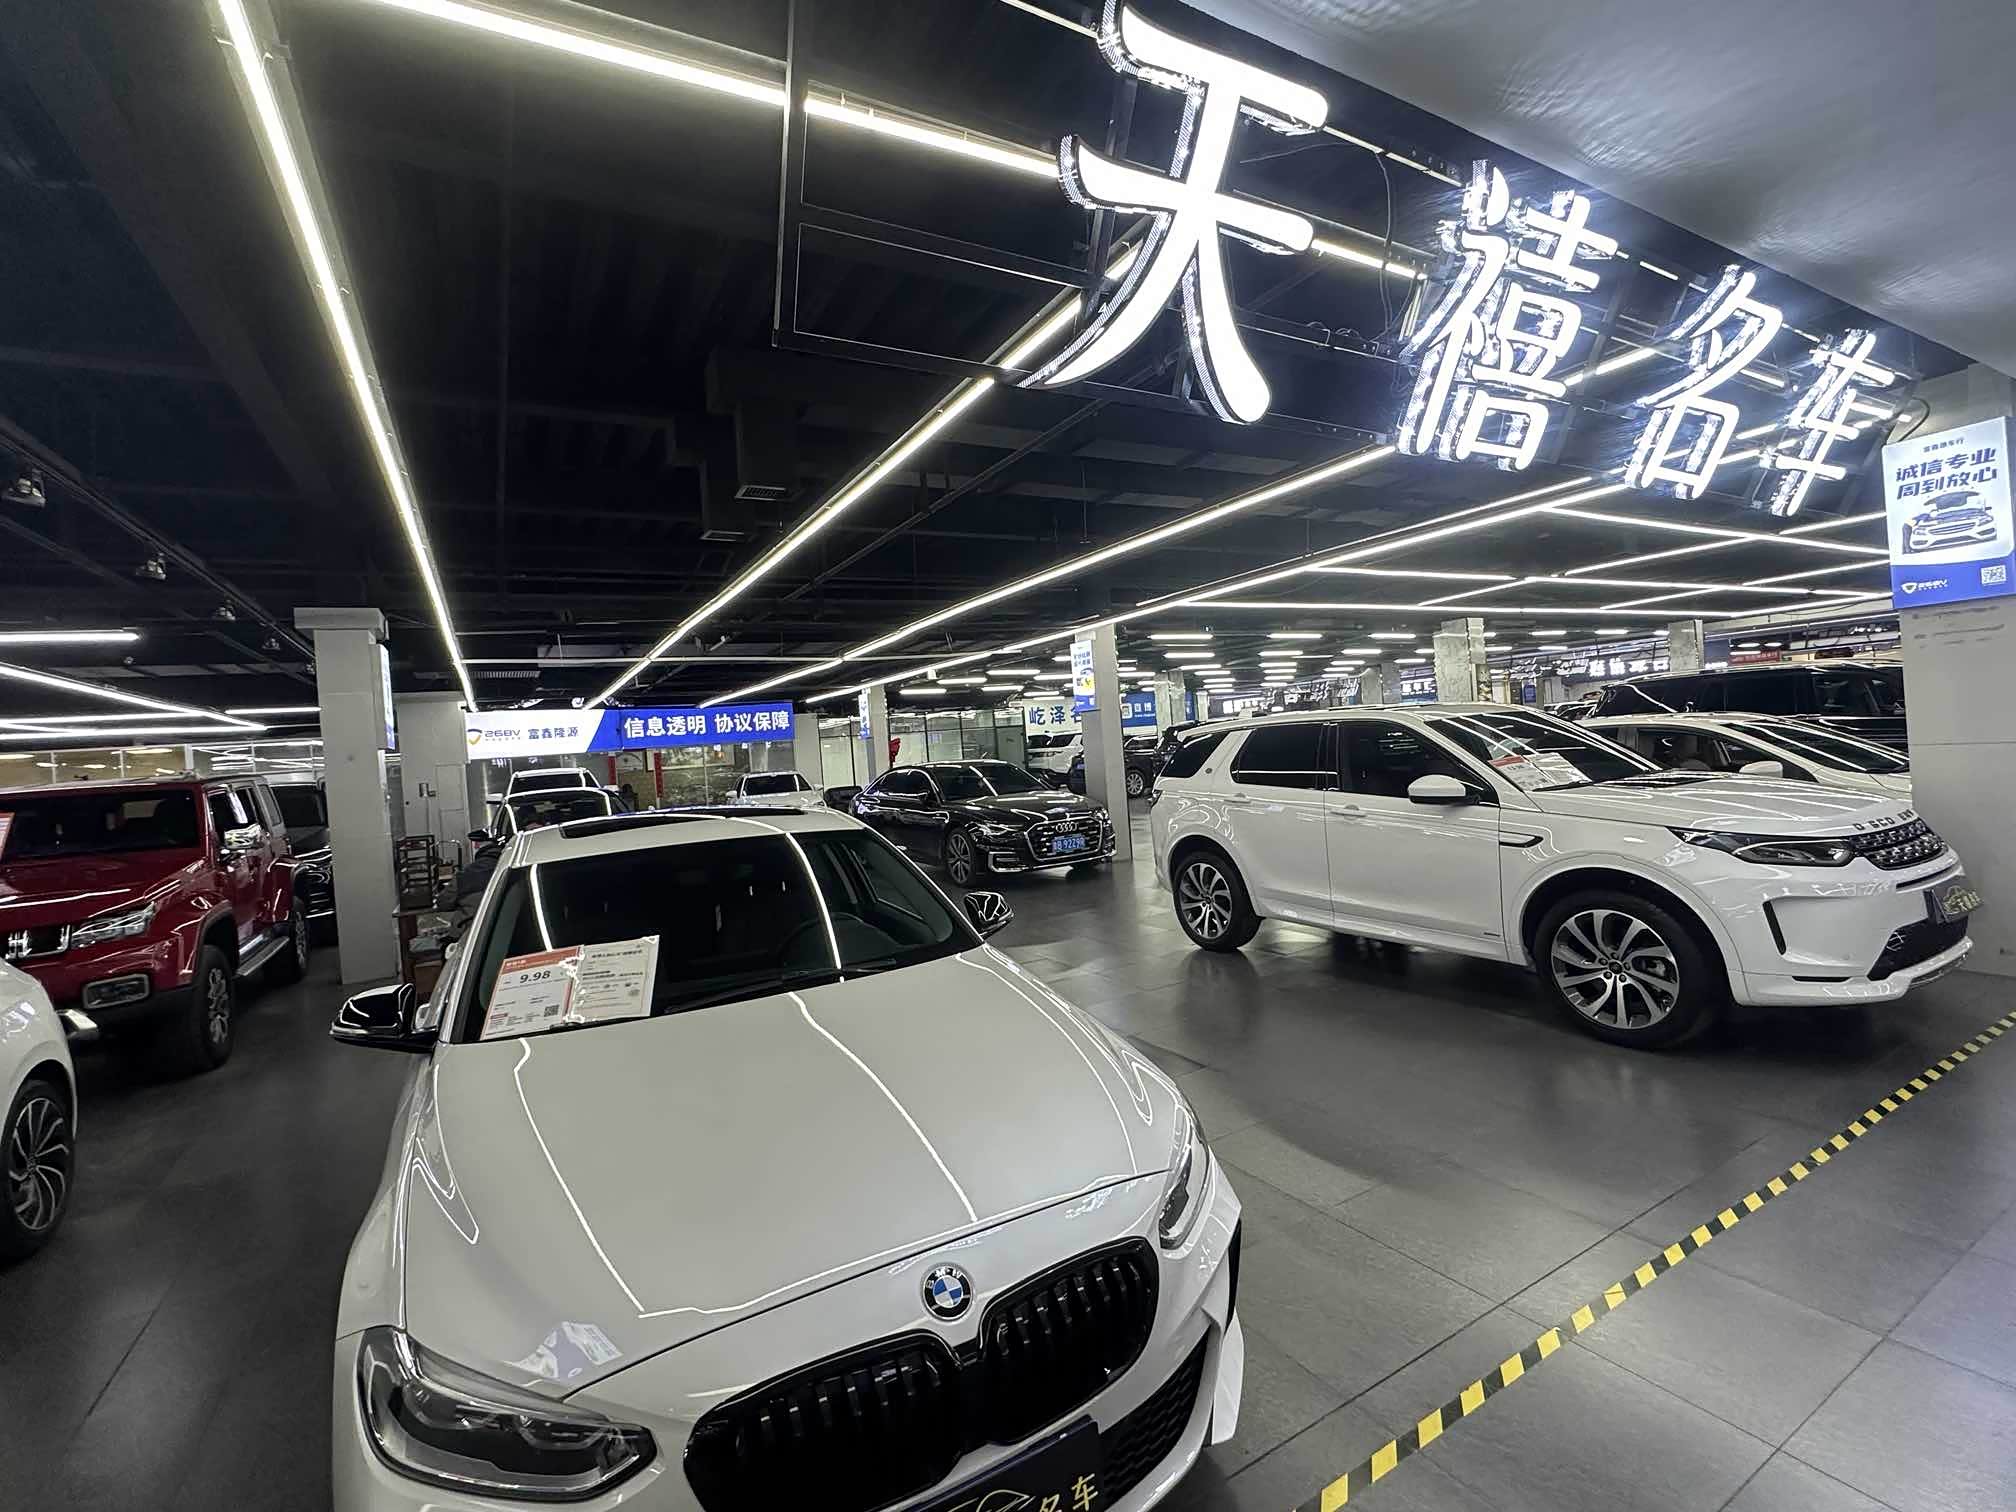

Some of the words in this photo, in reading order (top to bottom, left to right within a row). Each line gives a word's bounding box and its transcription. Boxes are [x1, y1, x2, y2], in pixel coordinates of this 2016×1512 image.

[1020, 2, 1896, 517] 天禧名车
[1896, 448, 1998, 482] 诚信专业
[1897, 466, 1998, 500] 周到放心
[527, 726, 578, 740] 富鑫隆源
[624, 715, 706, 738] 信息透明
[715, 711, 790, 733] 协议保障
[519, 970, 551, 984] 9.98
